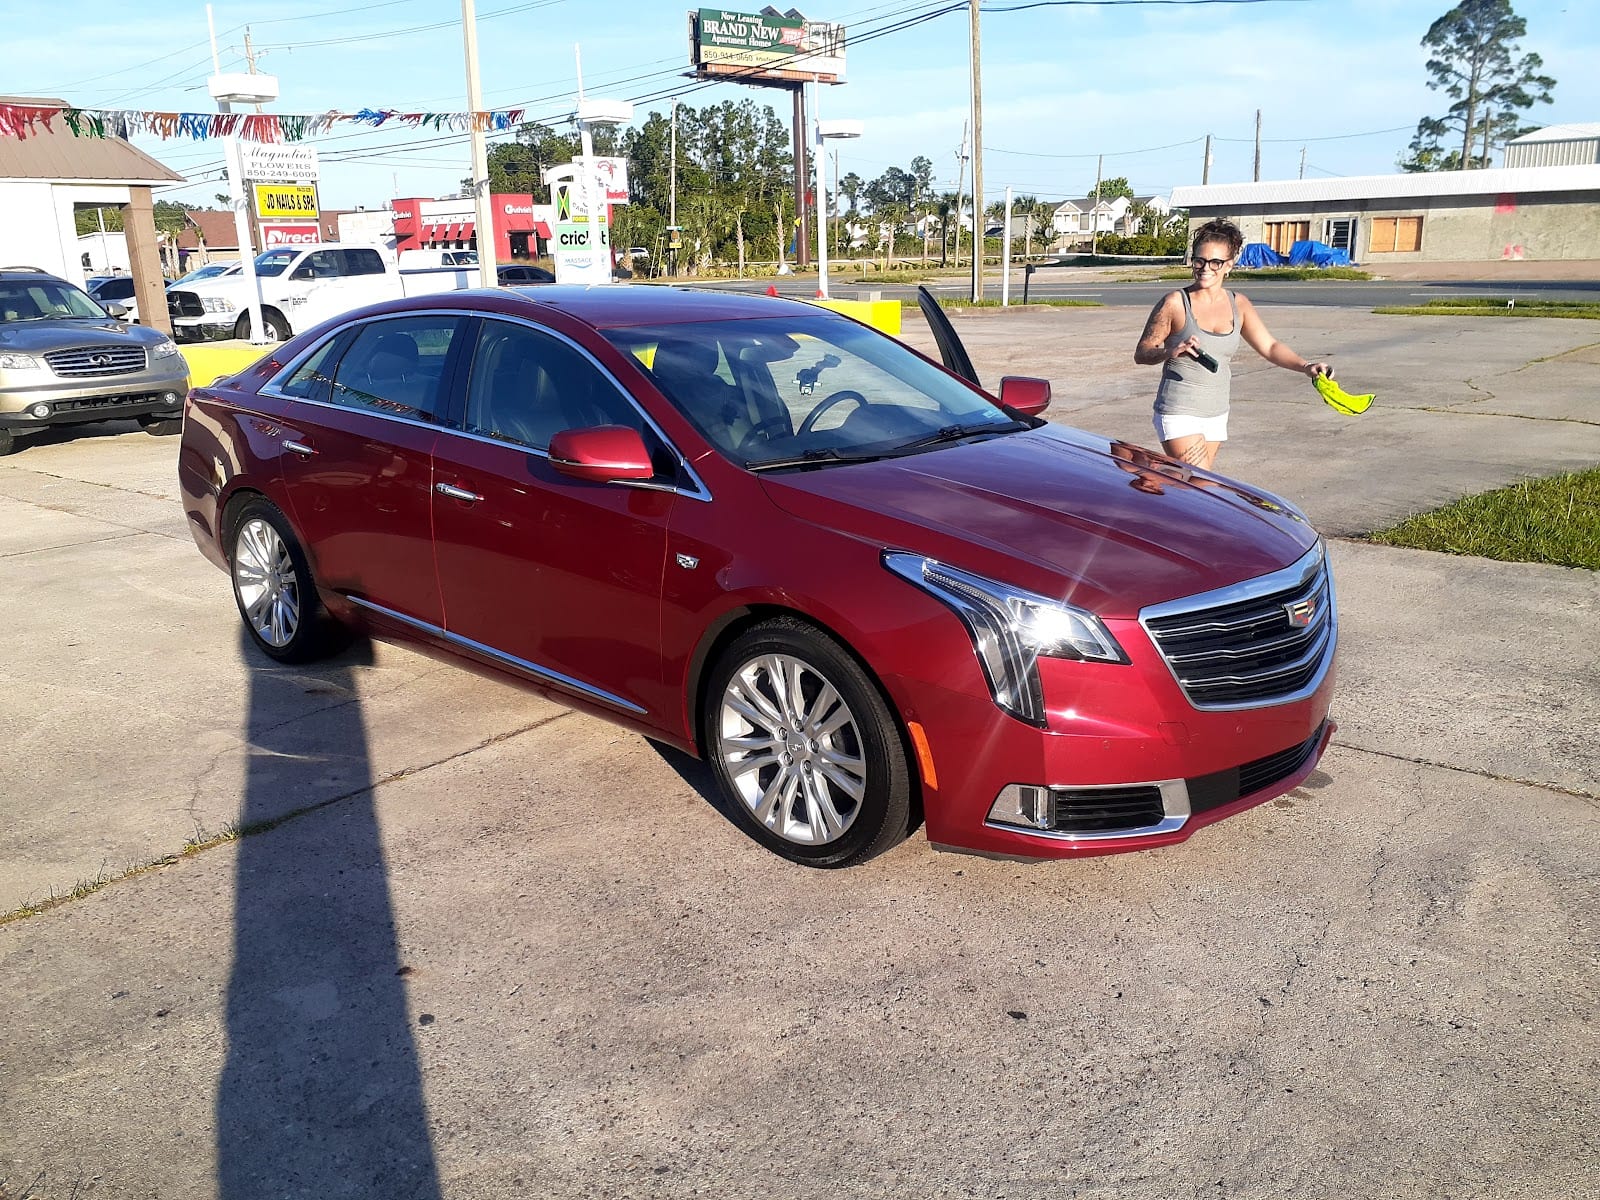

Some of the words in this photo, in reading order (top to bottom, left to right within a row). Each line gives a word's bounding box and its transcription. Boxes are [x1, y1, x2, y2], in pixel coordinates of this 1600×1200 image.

[721, 12, 736, 21] Now
[738, 14, 763, 26] Leasing
[703, 20, 747, 36] BRAND
[751, 25, 780, 40] NEW
[711, 35, 747, 45] Apartment
[749, 37, 772, 47] Homes
[243, 147, 312, 161] Magnolia's
[251, 162, 311, 170] FLOWERS
[266, 193, 275, 209] JD
[276, 194, 296, 210] NAILS
[297, 195, 302, 210] &
[303, 195, 316, 211] SPA
[266, 229, 318, 243] Direct
[560, 230, 606, 245] crict
